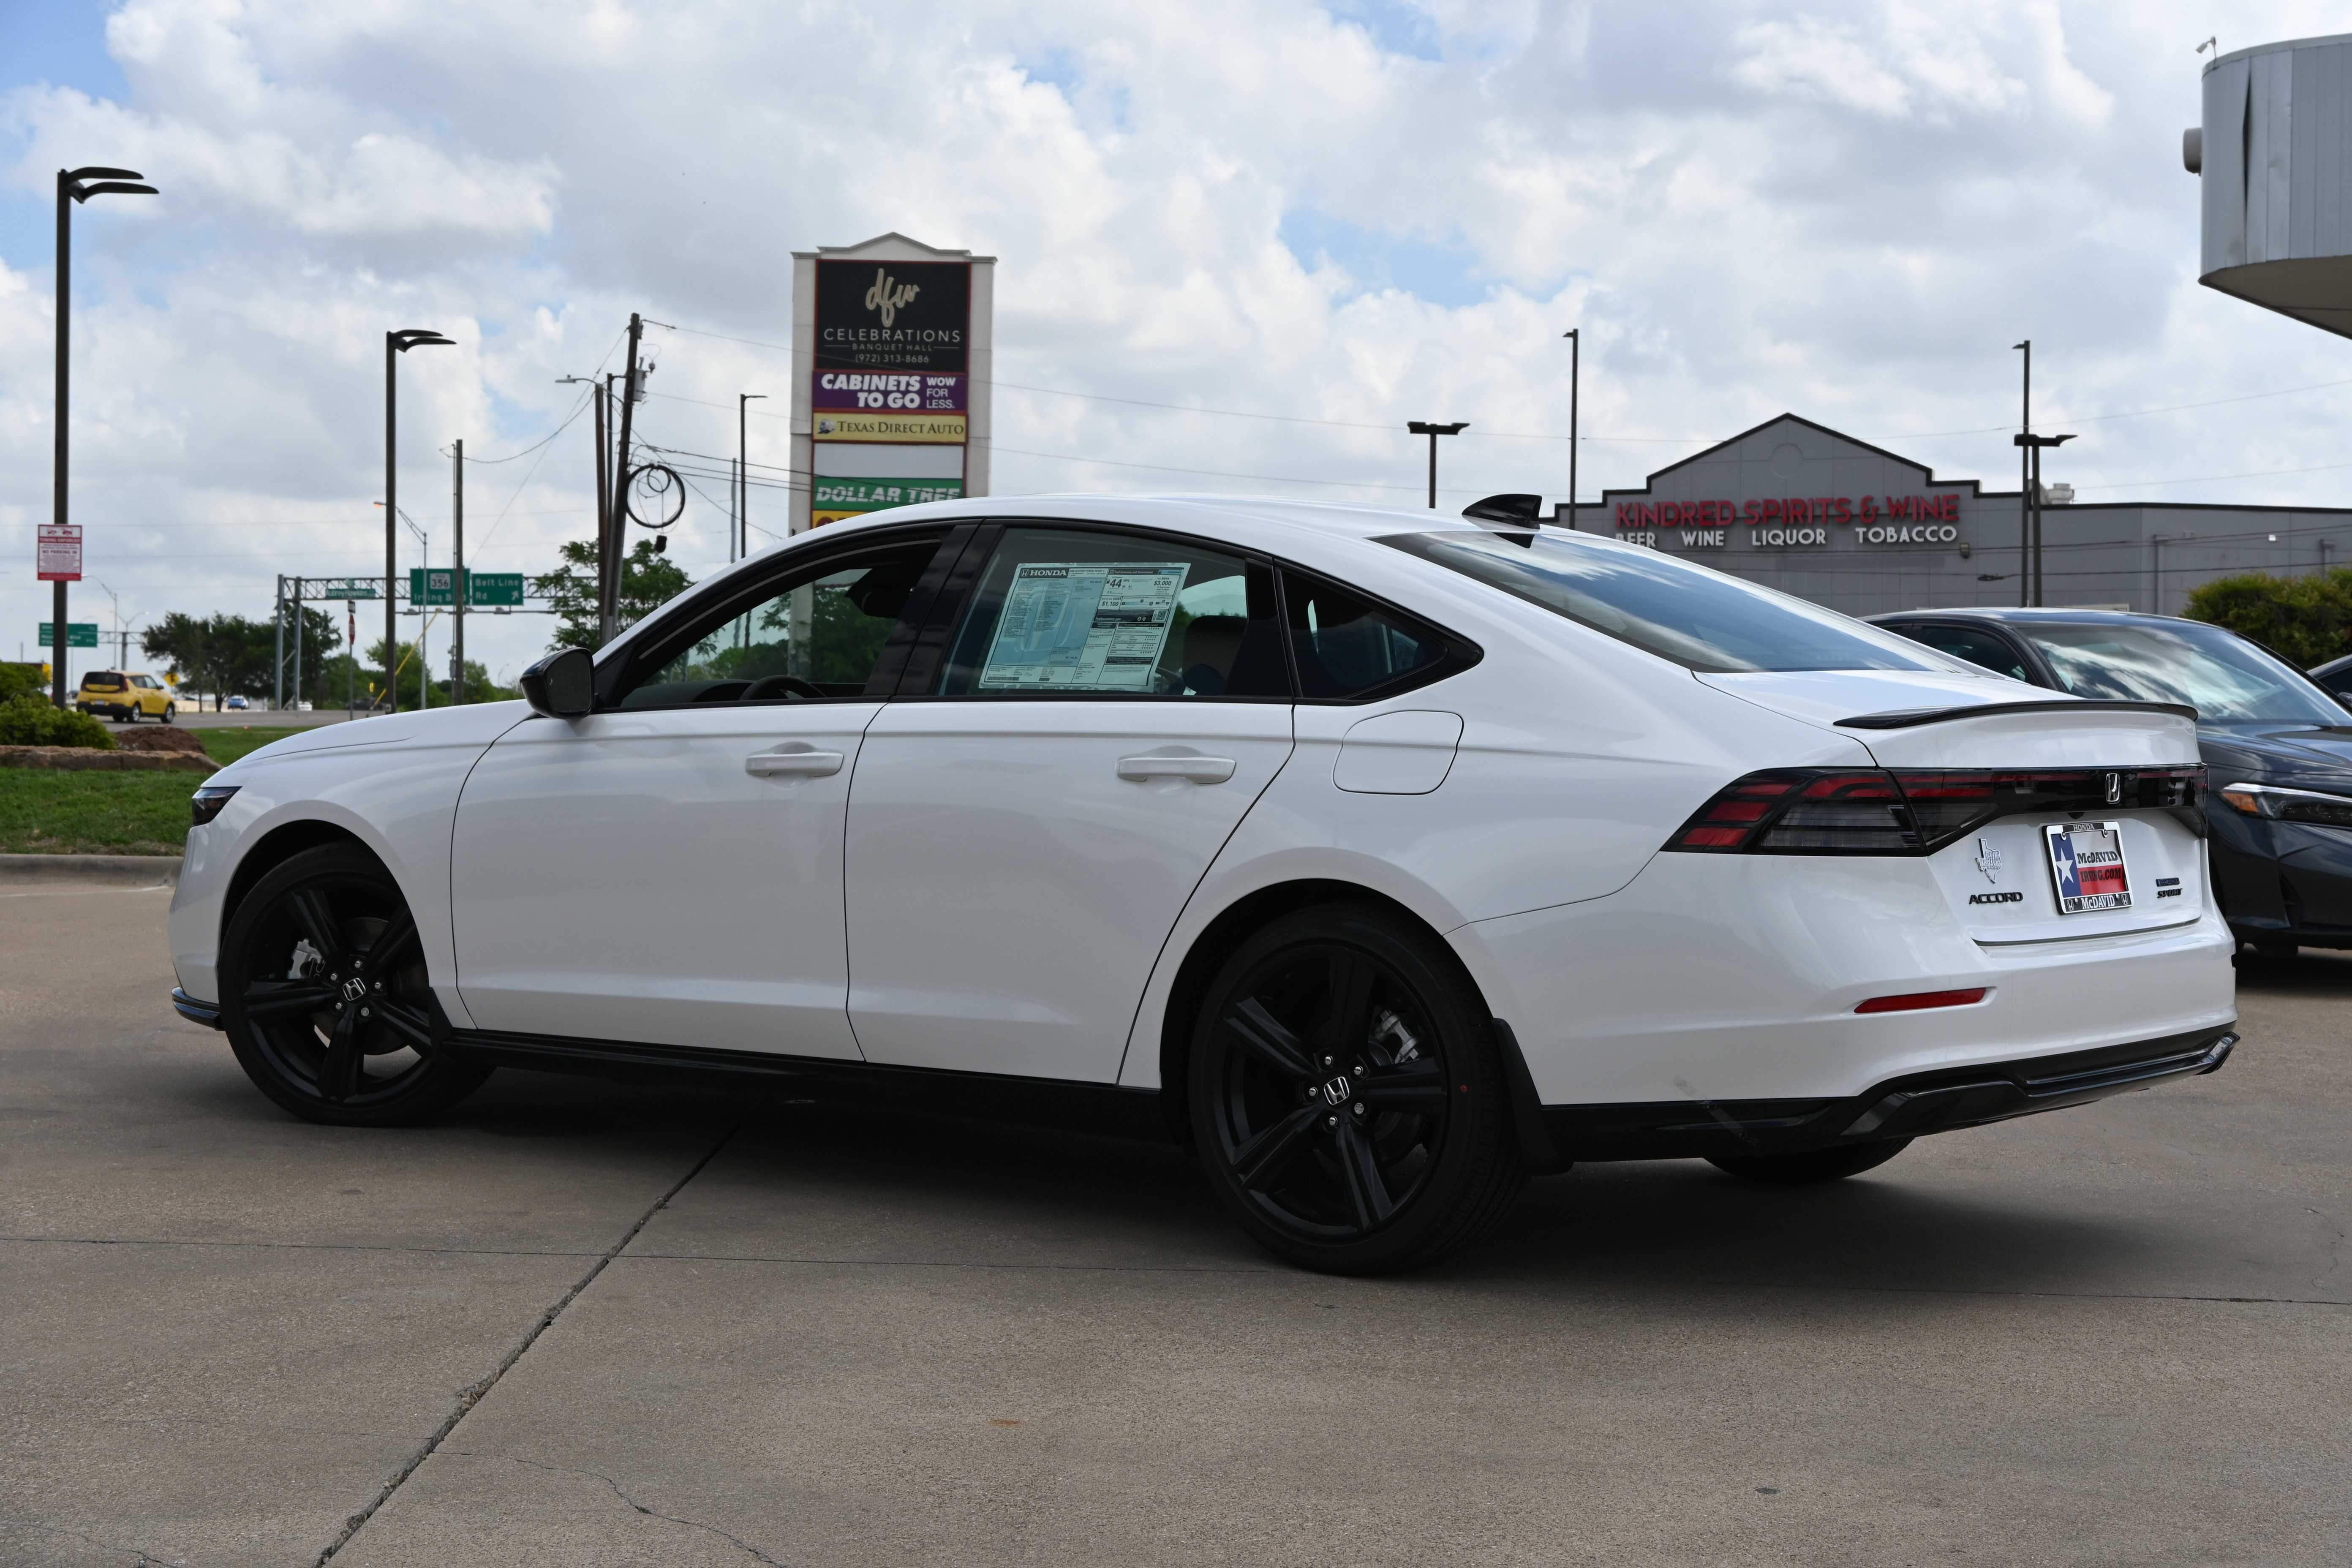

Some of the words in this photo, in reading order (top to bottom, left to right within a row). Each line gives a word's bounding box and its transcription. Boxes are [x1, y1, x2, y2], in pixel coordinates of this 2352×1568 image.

[824, 328, 960, 342] CELEBRATIONS
[855, 354, 880, 363] (972)
[883, 354, 929, 363] 313-8686
[821, 373, 921, 392] CABINETS
[926, 377, 956, 387] WOW
[926, 388, 948, 397] FOR
[857, 392, 884, 408] TO
[887, 392, 920, 408] GO
[926, 399, 955, 409] LESS.
[837, 421, 875, 433] TEXAS
[878, 422, 925, 434] DIRECT
[927, 423, 964, 435] AUTO
[816, 486, 901, 503] DOLLAR
[907, 487, 960, 503] TREE
[1616, 500, 1736, 528] KINDRED
[1743, 498, 1852, 525] SPIRITS
[1860, 495, 1879, 524] &
[1886, 494, 1960, 522] WINE
[1681, 531, 1724, 547] WINE
[1752, 528, 1827, 546] LIQUOR
[1855, 525, 1957, 544] TOBACCO
[431, 579, 449, 588] 356
[475, 578, 494, 586] Belt
[498, 578, 519, 587] Line
[1109, 579, 1122, 588] 44
[414, 593, 442, 602] Iring
[446, 593, 466, 601] Bd
[475, 592, 487, 600] Rd
[2077, 851, 2118, 864] McDAVID
[2080, 868, 2122, 883] IRVING.COM
[1969, 892, 2023, 905] ACCORD
[2157, 888, 2183, 898] SPORT
[2080, 895, 2115, 910] McDAVID
